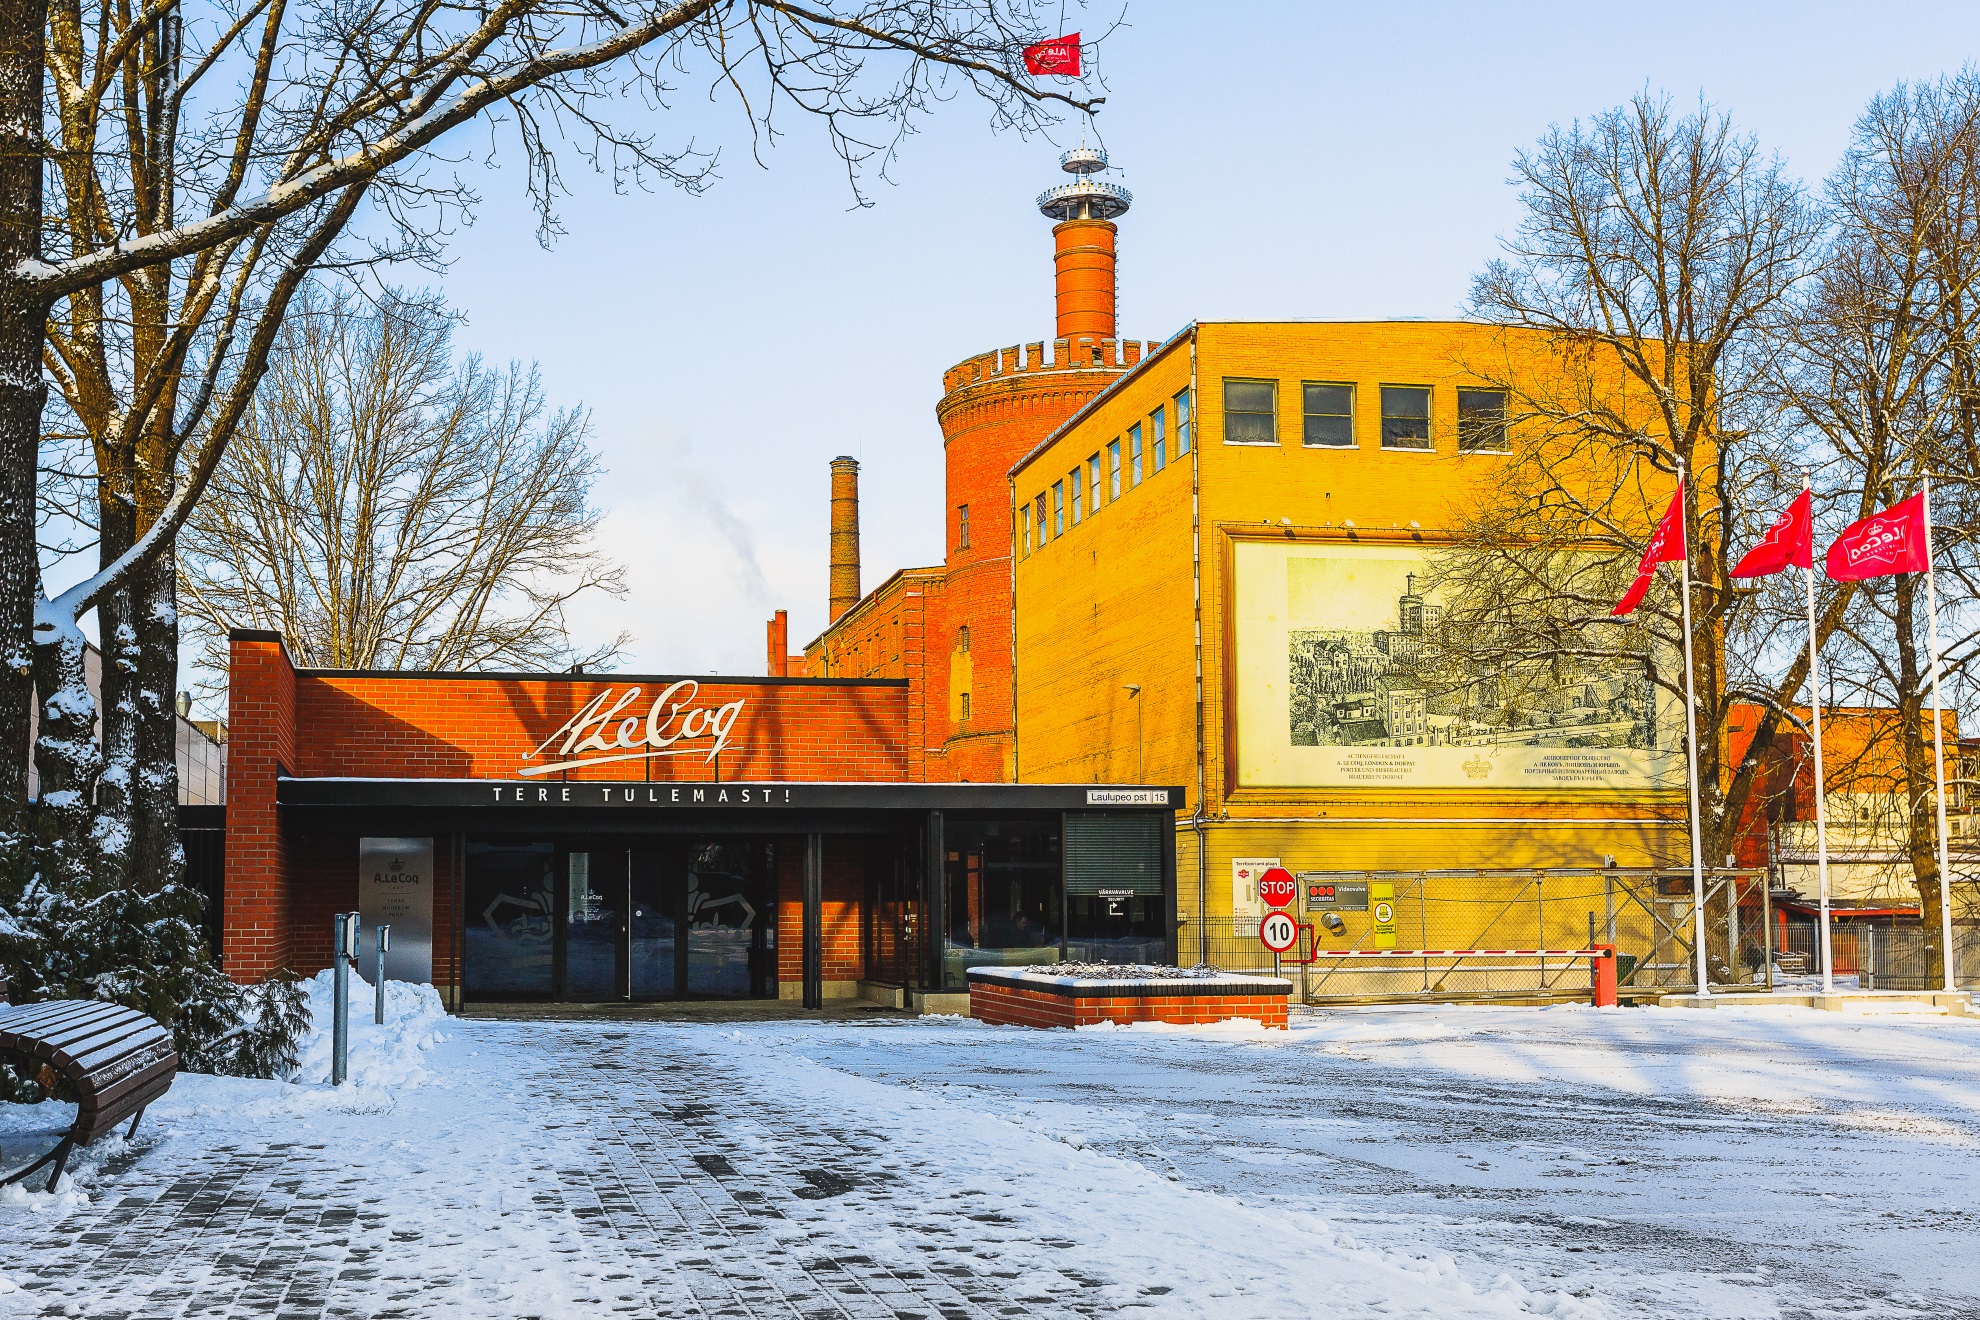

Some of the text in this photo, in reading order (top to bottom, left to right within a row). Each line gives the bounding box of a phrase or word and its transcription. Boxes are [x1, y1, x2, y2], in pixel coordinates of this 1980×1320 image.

[493, 787, 790, 803] TERE TULEMAST!
[1091, 792, 1165, 803] Laulupeo pst 15
[374, 873, 419, 885] A.LeCoq
[1260, 881, 1294, 895] STOP
[1269, 922, 1290, 941] 10
